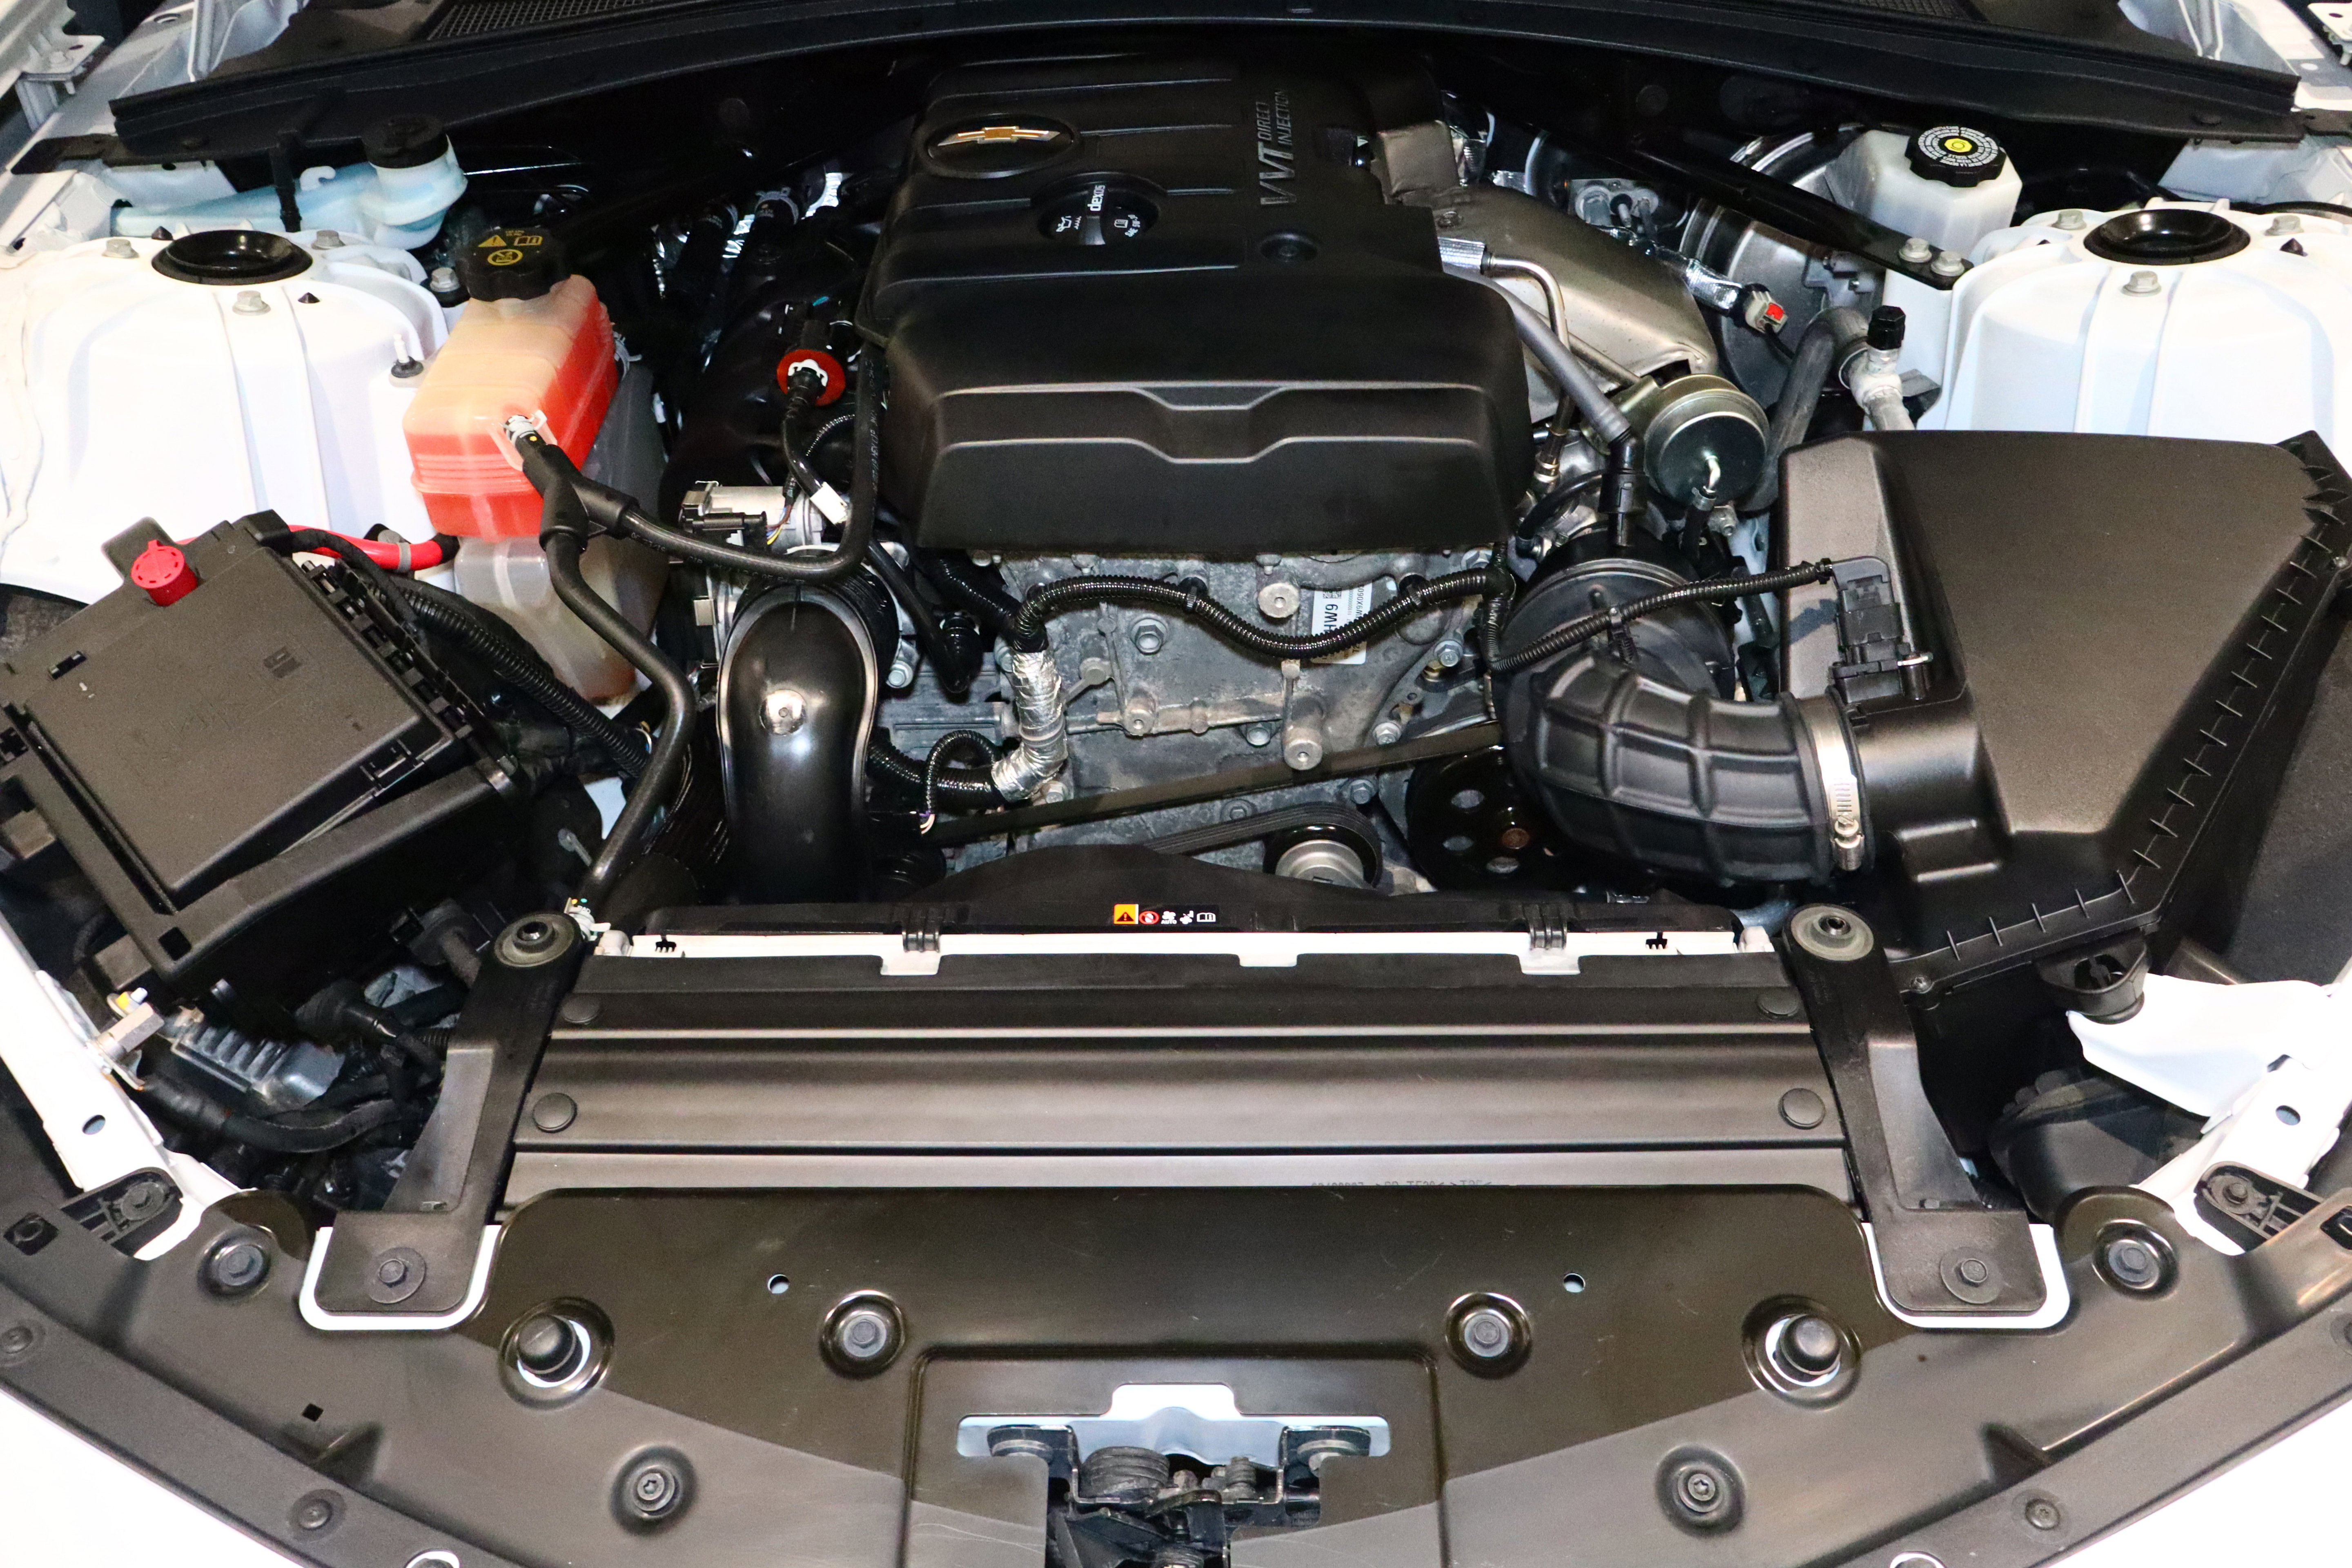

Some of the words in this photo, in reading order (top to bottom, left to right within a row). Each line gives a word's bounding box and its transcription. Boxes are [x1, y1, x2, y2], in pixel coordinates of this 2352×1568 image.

[1256, 101, 1272, 141] DIRECT
[1274, 89, 1293, 146] INJECTION
[1258, 141, 1296, 205] VVT
[1087, 185, 1105, 212] dexos
